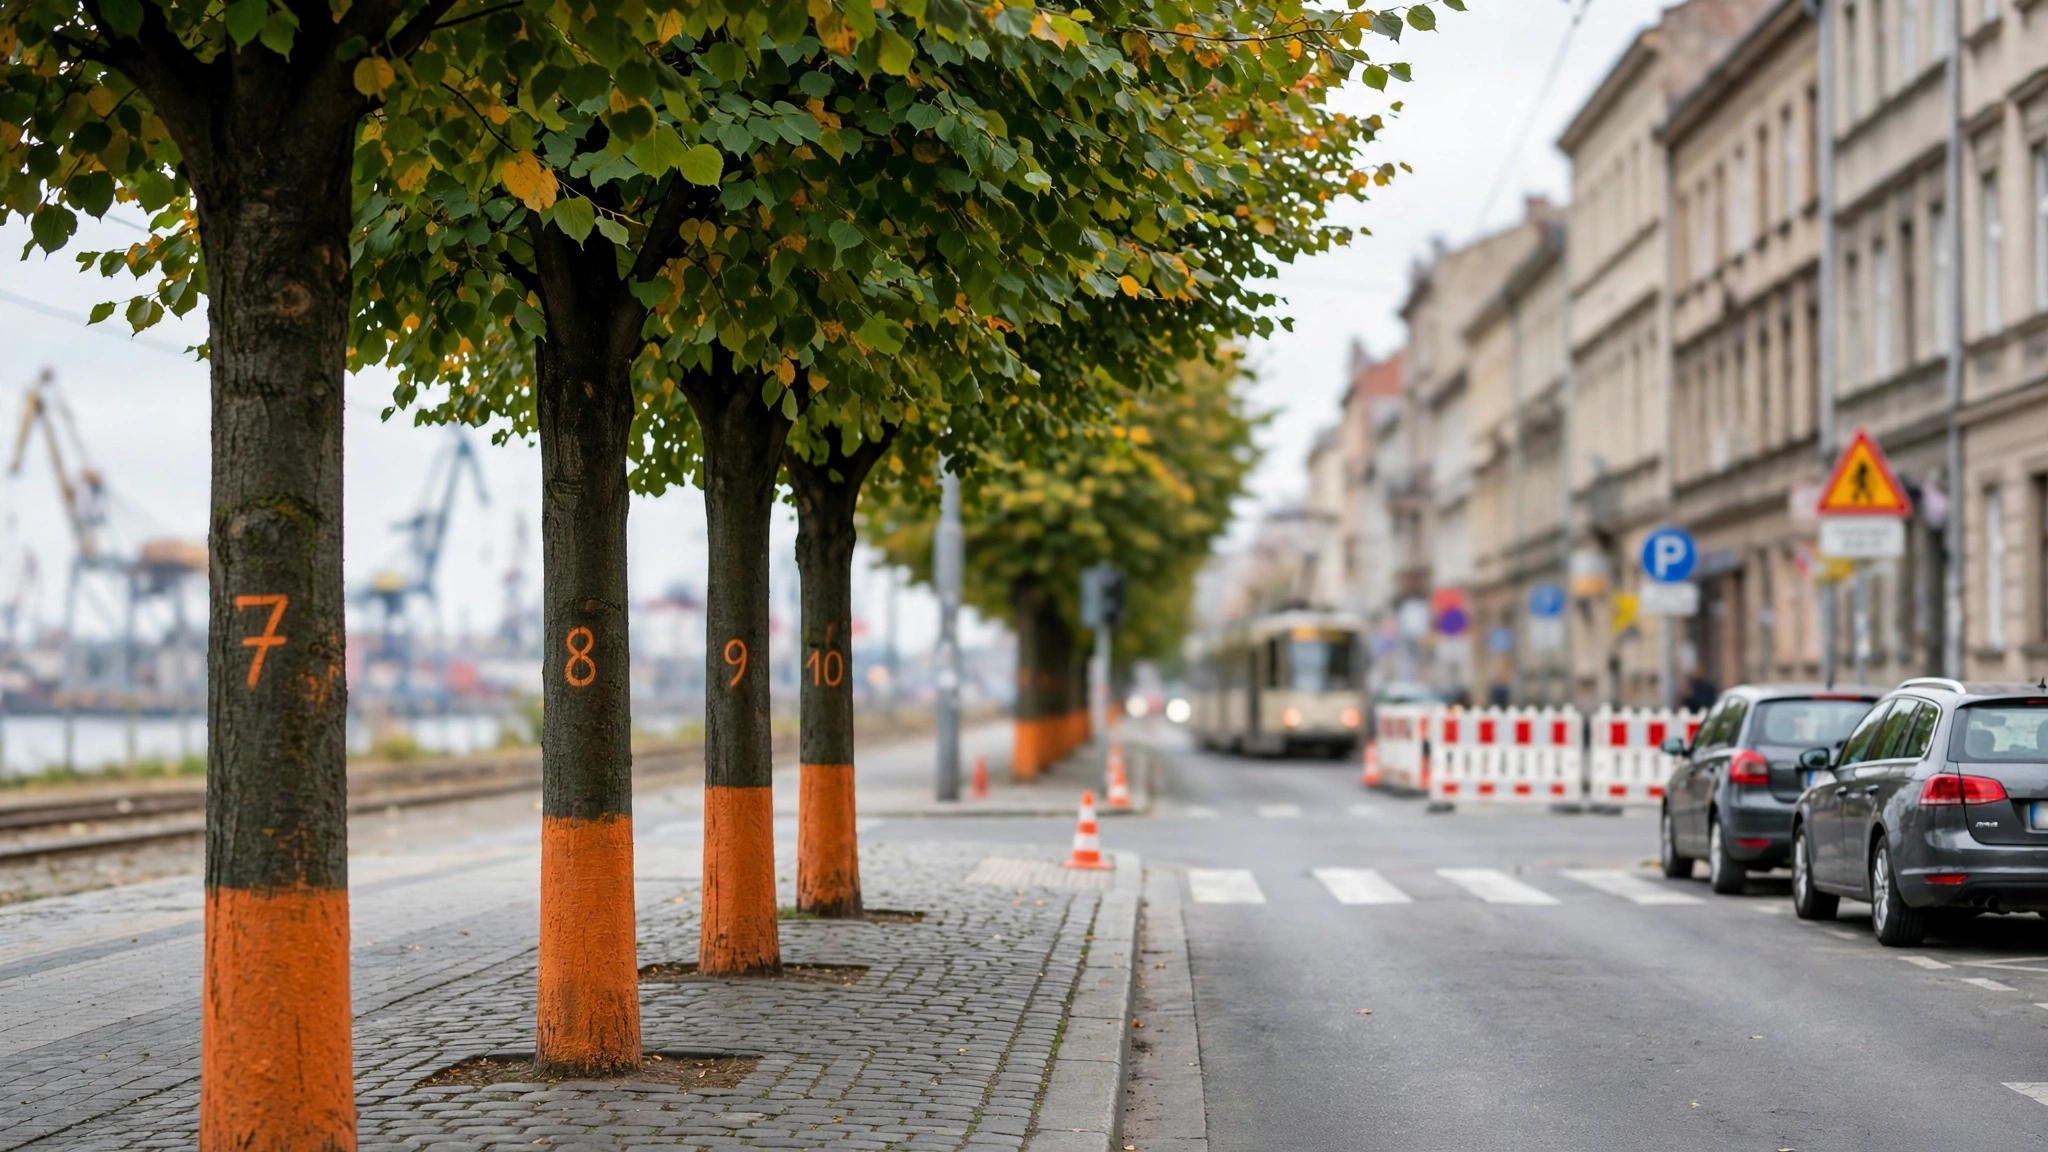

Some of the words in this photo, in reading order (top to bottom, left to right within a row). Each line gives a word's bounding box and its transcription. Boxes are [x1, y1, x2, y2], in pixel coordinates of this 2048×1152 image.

[1655, 535, 1687, 580] P
[234, 594, 288, 689] 7
[564, 626, 596, 687] 8
[723, 639, 747, 687] 9
[806, 650, 844, 687] 10
